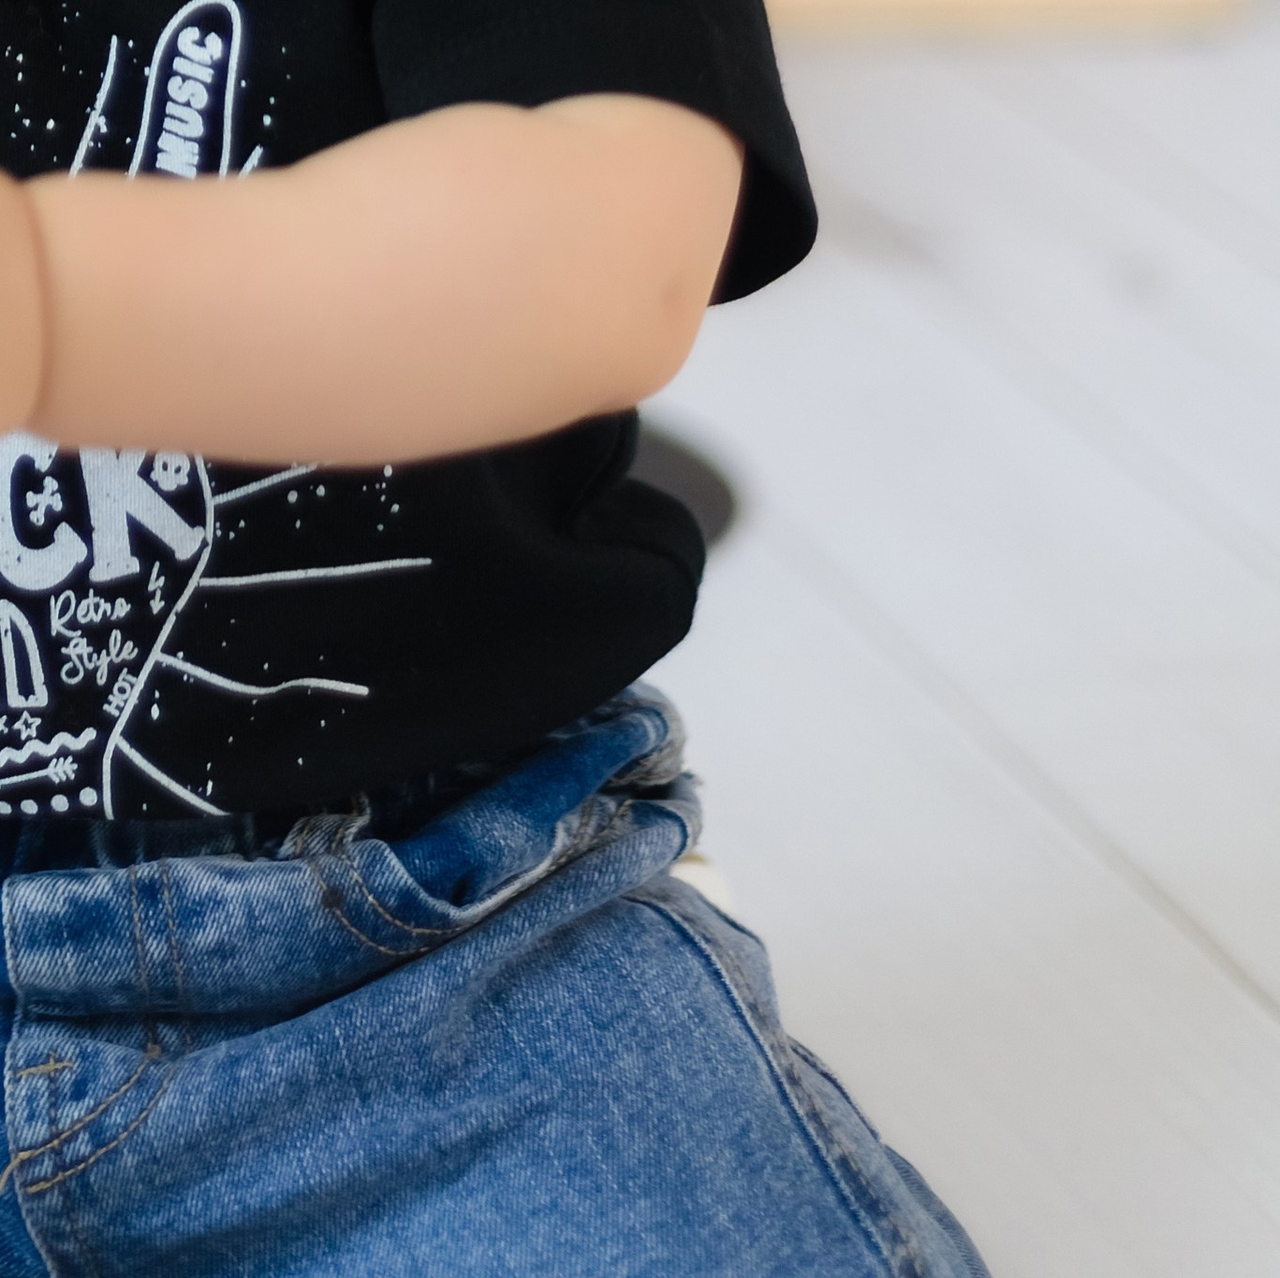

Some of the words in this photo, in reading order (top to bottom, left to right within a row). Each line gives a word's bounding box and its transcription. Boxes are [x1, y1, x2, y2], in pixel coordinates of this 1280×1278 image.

[155, 25, 223, 179] MUSIC
[49, 587, 132, 638] Retro
[60, 628, 139, 686] Style
[102, 667, 138, 718] HOT
